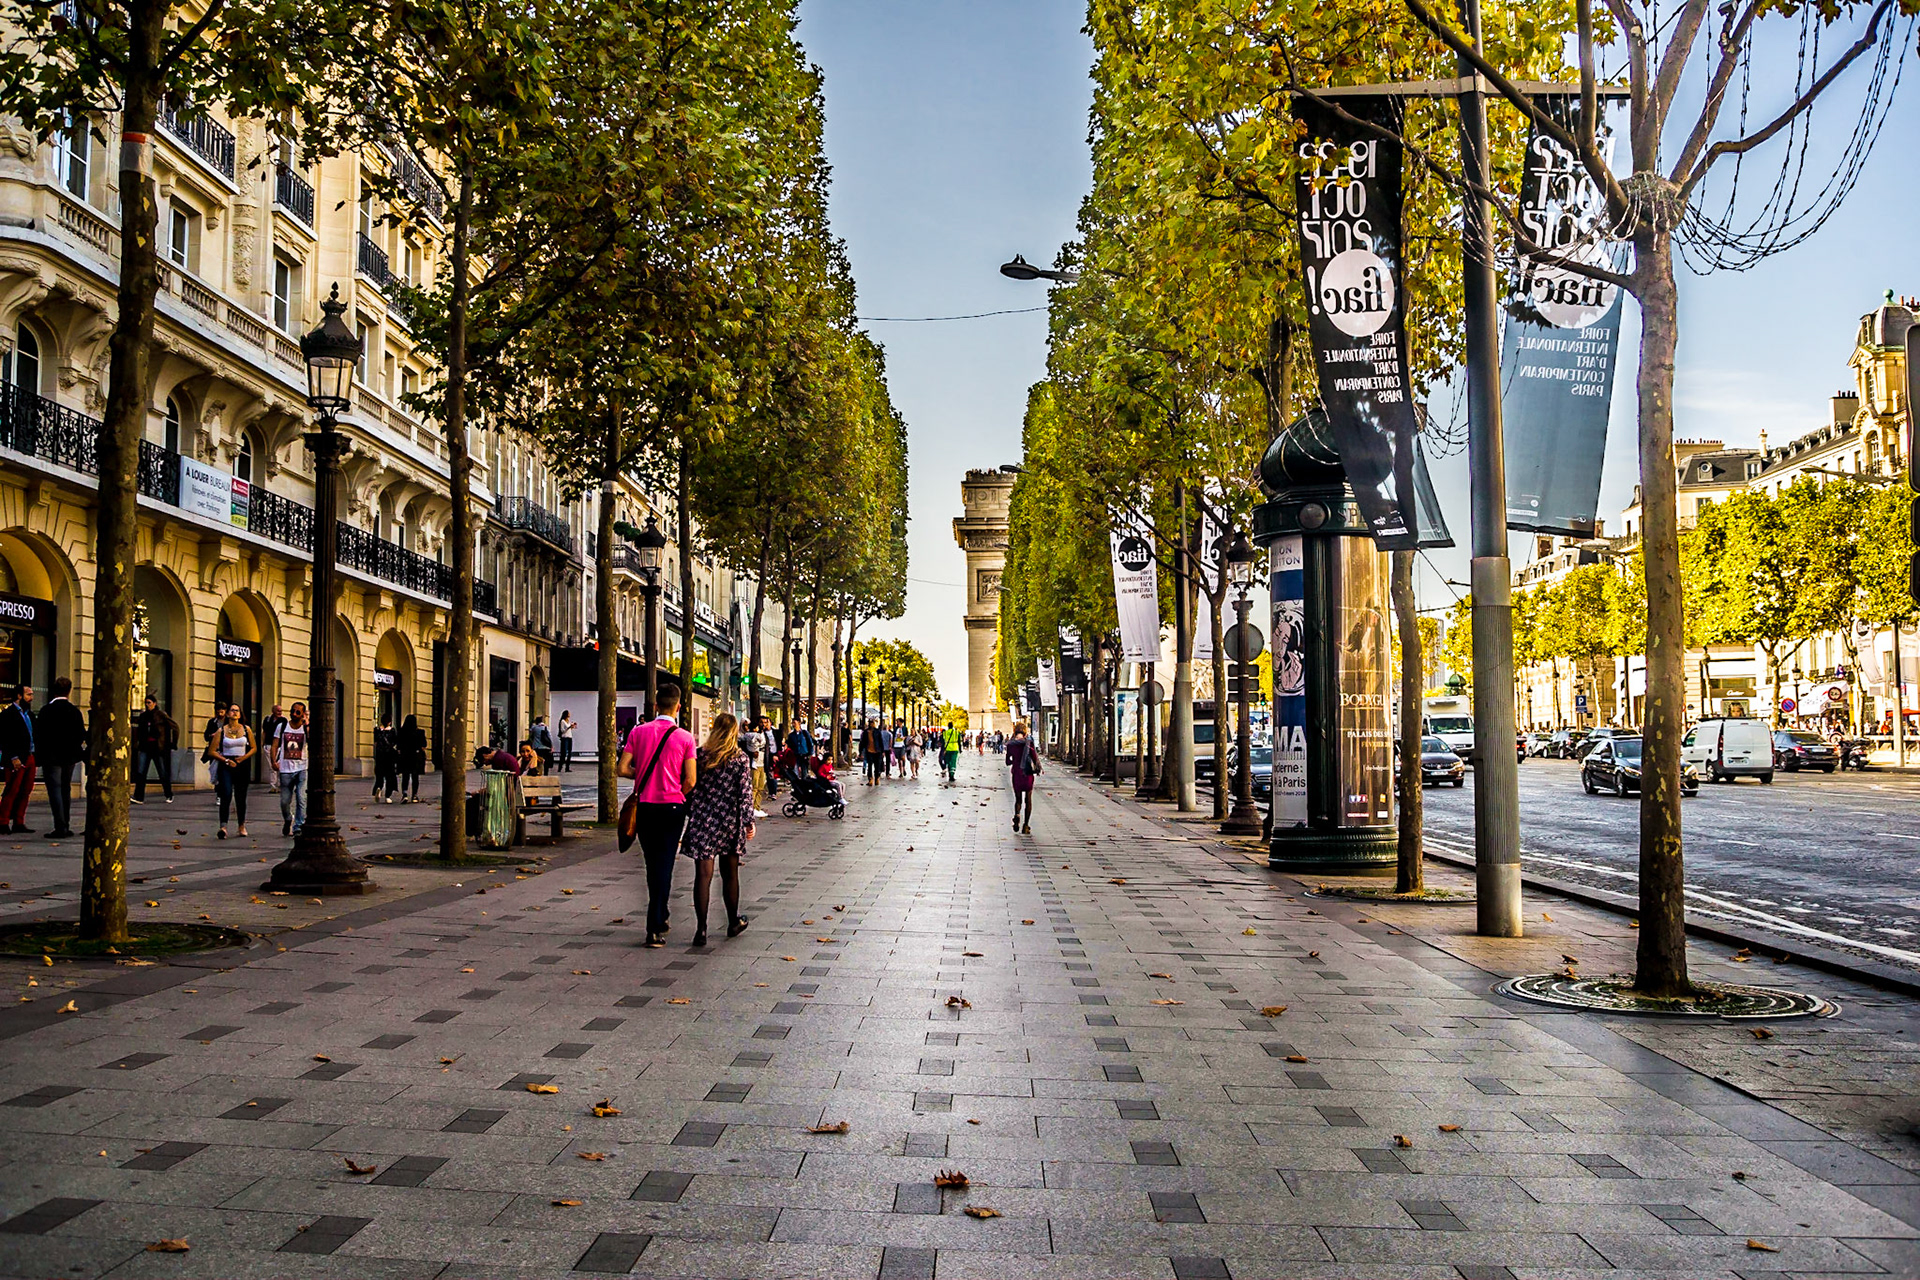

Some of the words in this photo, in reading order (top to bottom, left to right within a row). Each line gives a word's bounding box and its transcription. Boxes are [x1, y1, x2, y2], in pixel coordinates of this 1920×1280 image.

[191, 469, 209, 484] LOUER
[218, 639, 251, 659] NESPRESSO
[1578, 697, 1584, 705] P
[1283, 776, 1306, 788] Paris
